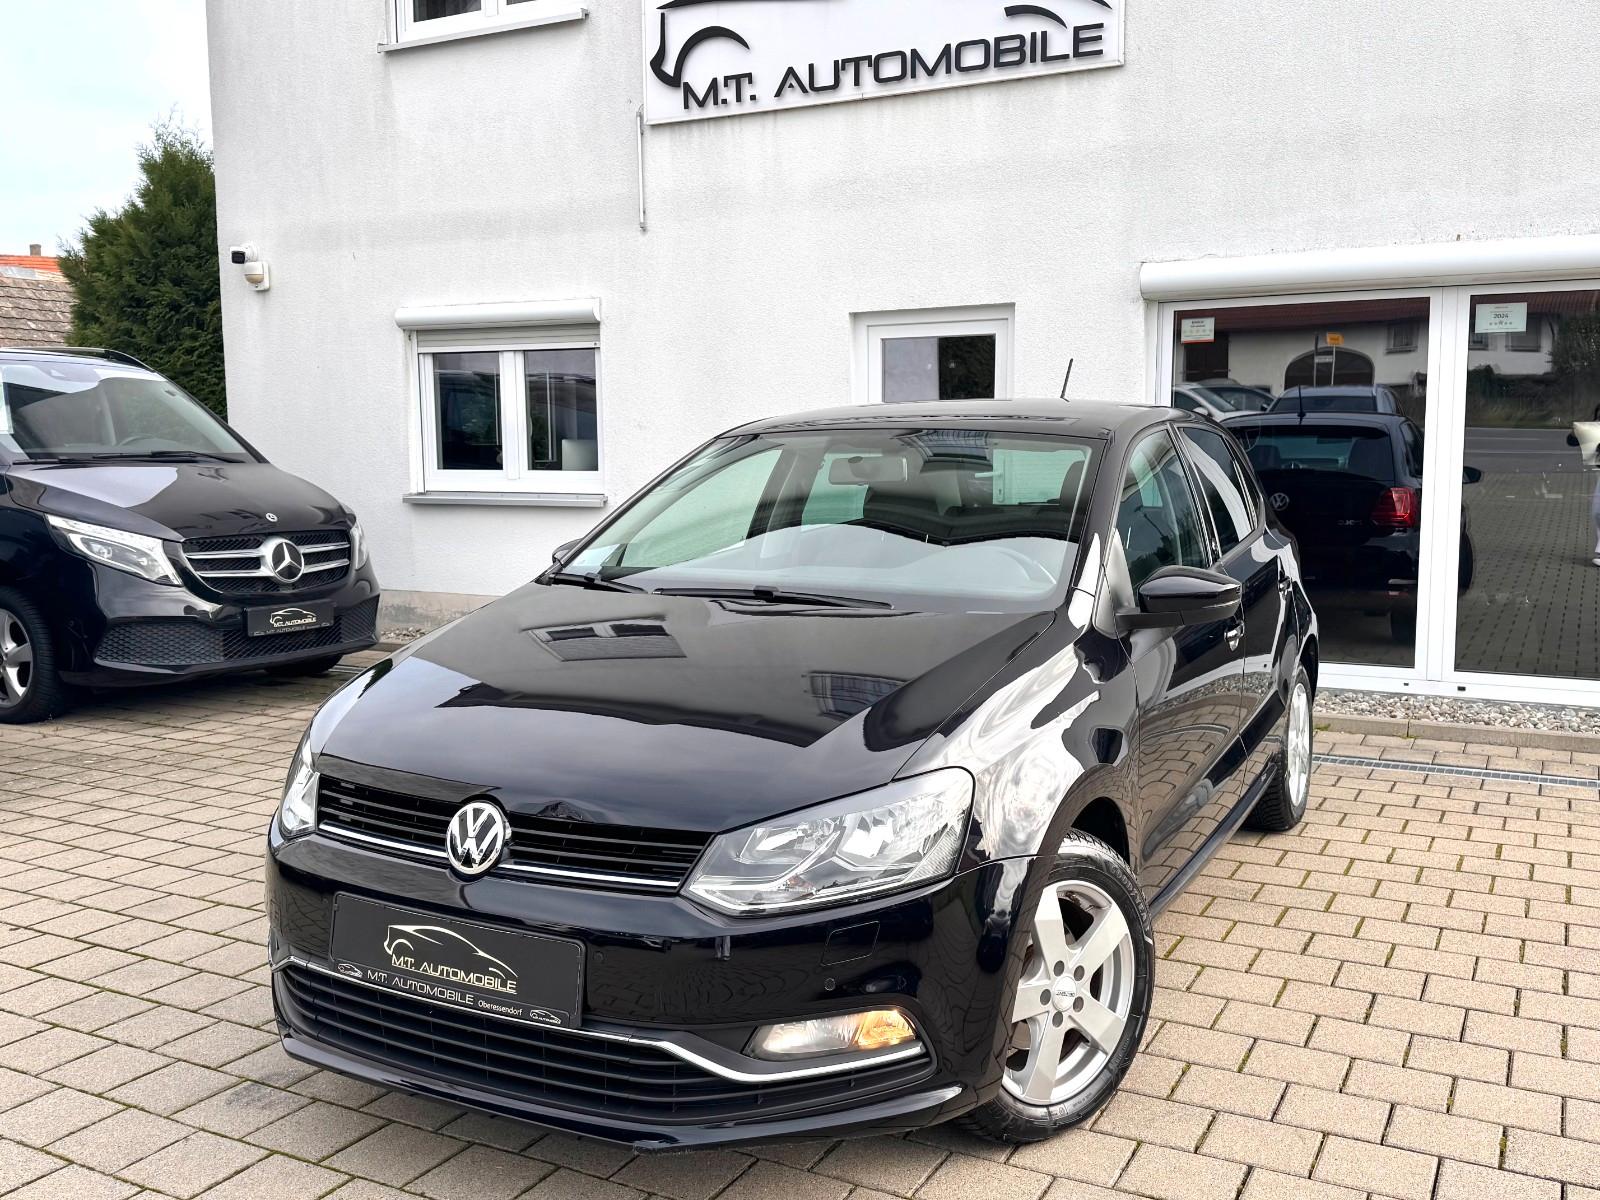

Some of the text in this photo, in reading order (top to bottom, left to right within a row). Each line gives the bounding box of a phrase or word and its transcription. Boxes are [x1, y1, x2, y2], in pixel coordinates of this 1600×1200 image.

[683, 23, 1104, 109] M.T. AUTOMOBILE
[367, 970, 388, 984] M.T.
[392, 977, 474, 1005] AUTOMOBILE
[478, 1000, 523, 1016] Oberessendorf
[391, 953, 517, 992] M.T. AUTOMOBILE
